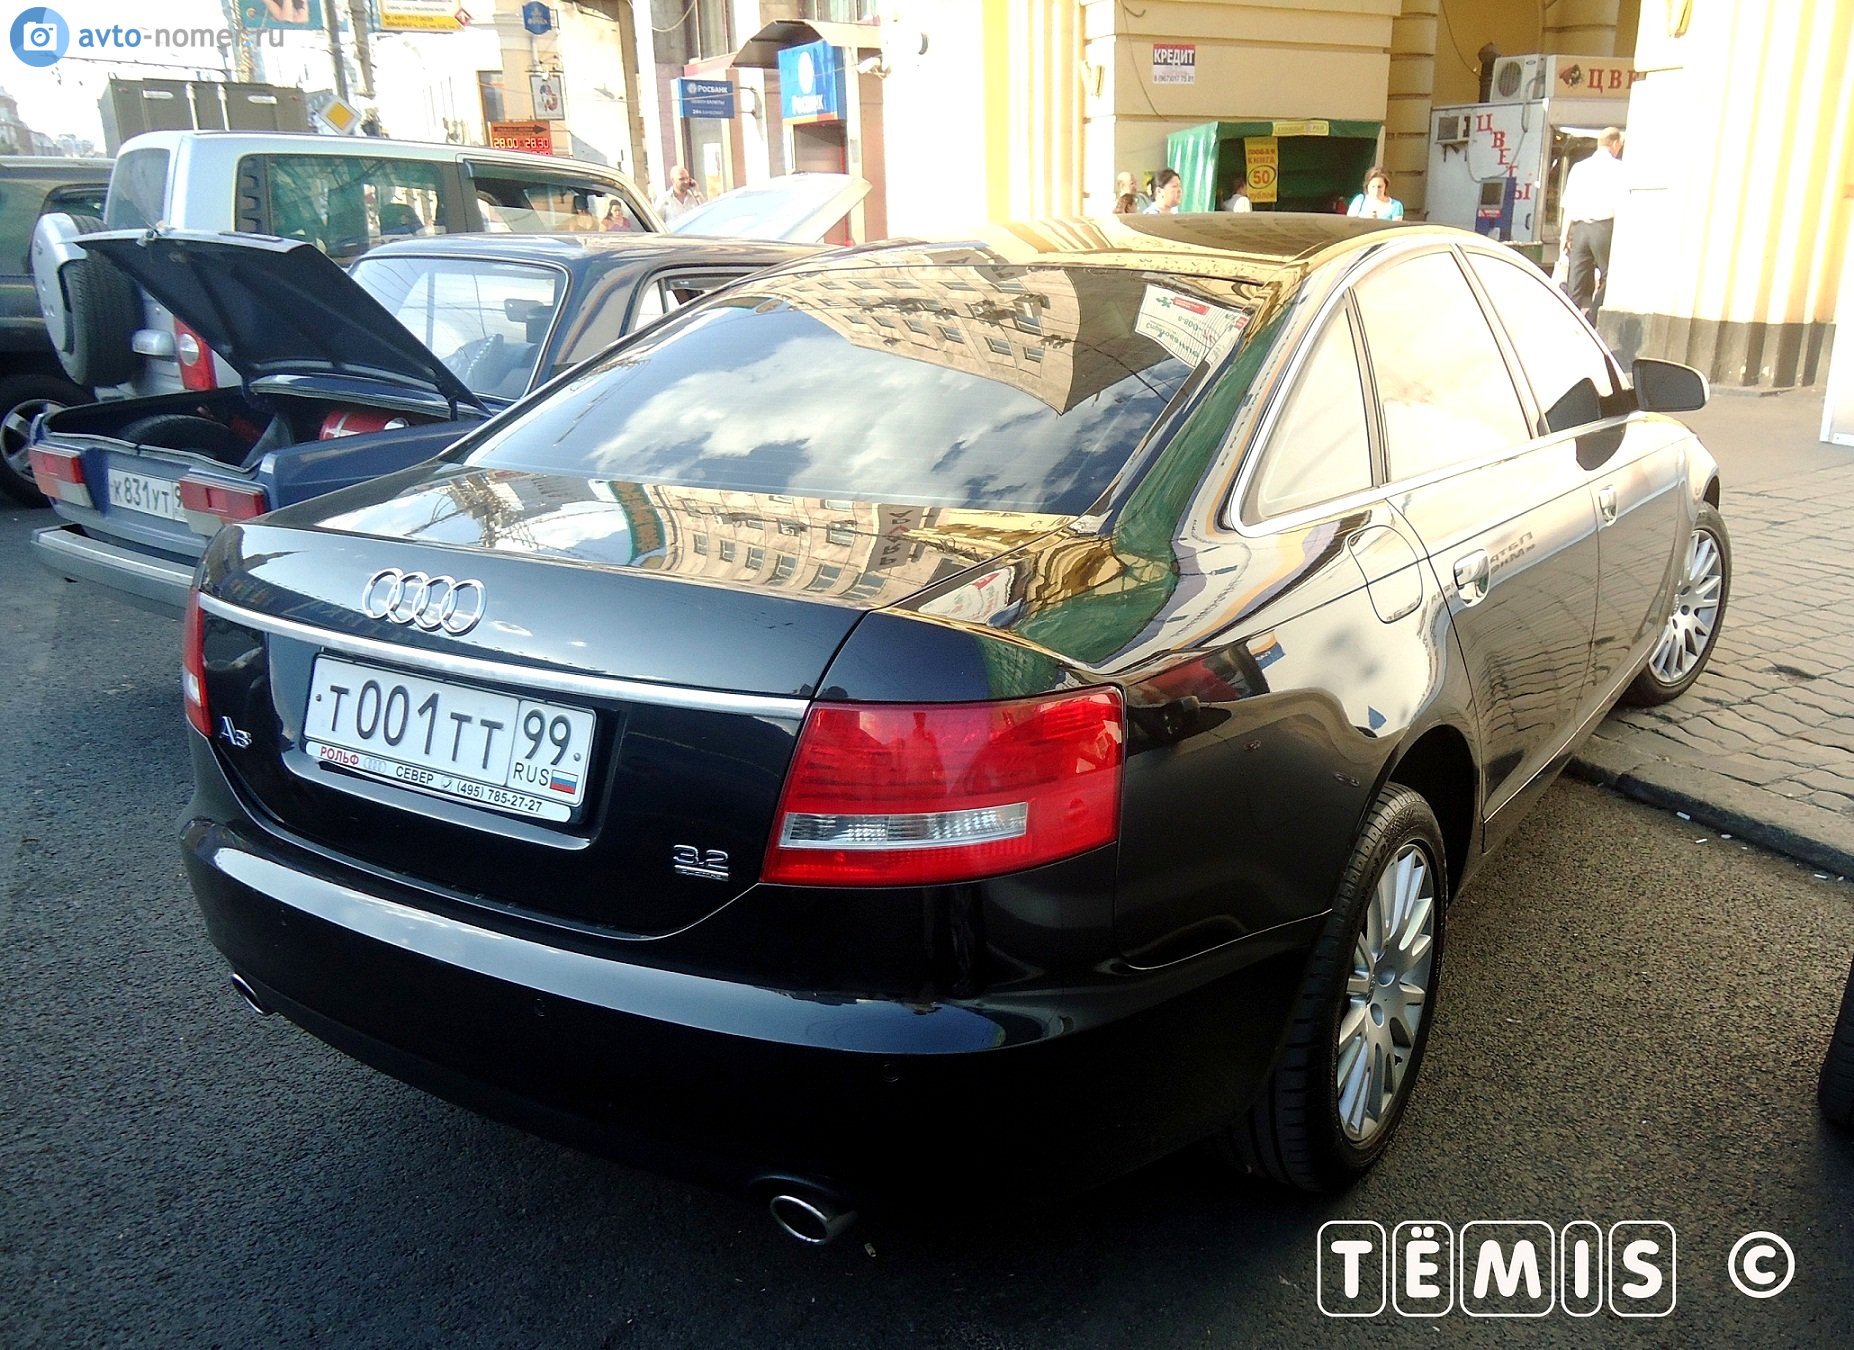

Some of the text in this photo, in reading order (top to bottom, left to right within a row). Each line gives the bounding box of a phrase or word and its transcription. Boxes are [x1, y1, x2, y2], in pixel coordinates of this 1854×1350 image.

[1154, 48, 1195, 66] КРЕДИТ
[1587, 69, 1647, 94] ЦВЕ
[1253, 170, 1270, 185] 50
[112, 477, 170, 513] К831УТ
[330, 679, 572, 770] Т001ТТ 99
[320, 745, 543, 812] РОЛЬФ СЕВЕР (495) 785-27-27
[513, 762, 550, 786] RUS
[673, 844, 729, 871] 3.2
